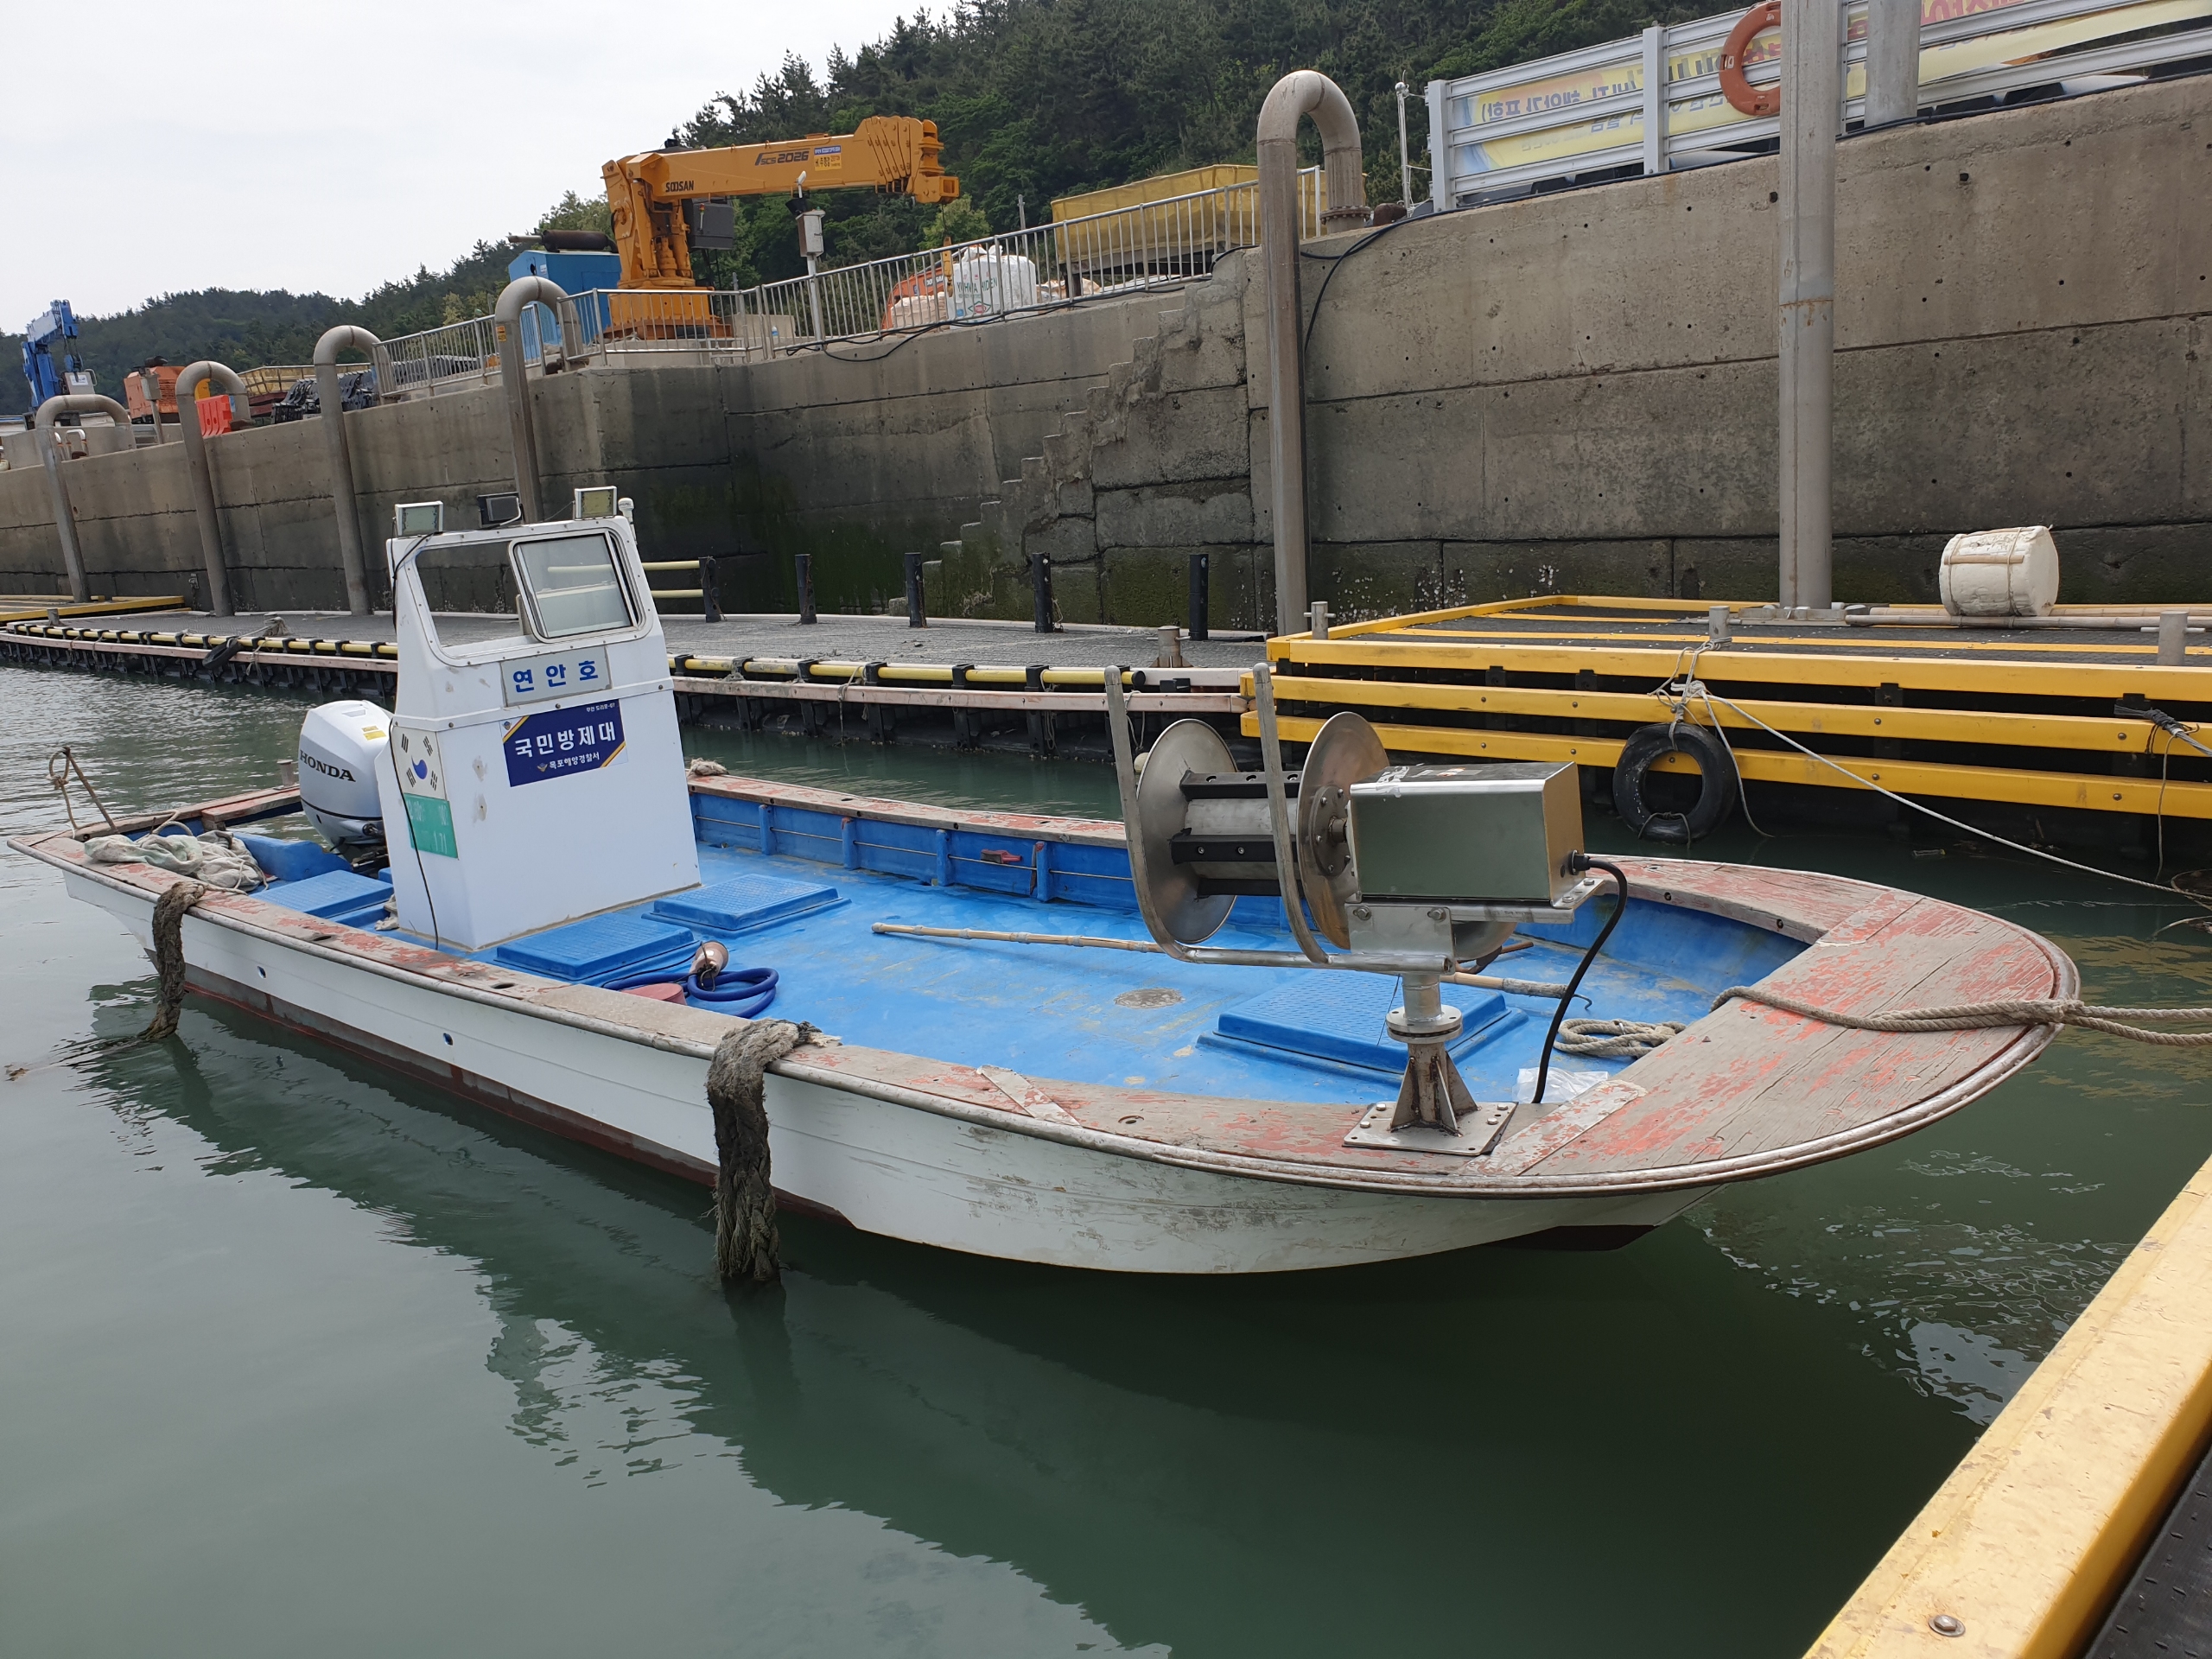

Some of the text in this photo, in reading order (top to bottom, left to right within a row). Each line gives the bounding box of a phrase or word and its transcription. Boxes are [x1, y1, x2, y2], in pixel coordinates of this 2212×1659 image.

[778, 150, 810, 164] 2026
[665, 180, 695, 193] SOOSAN
[514, 721, 616, 758] 국민방제대
[299, 749, 356, 783] HONDA
[549, 751, 601, 770] 목포해양경찰서
